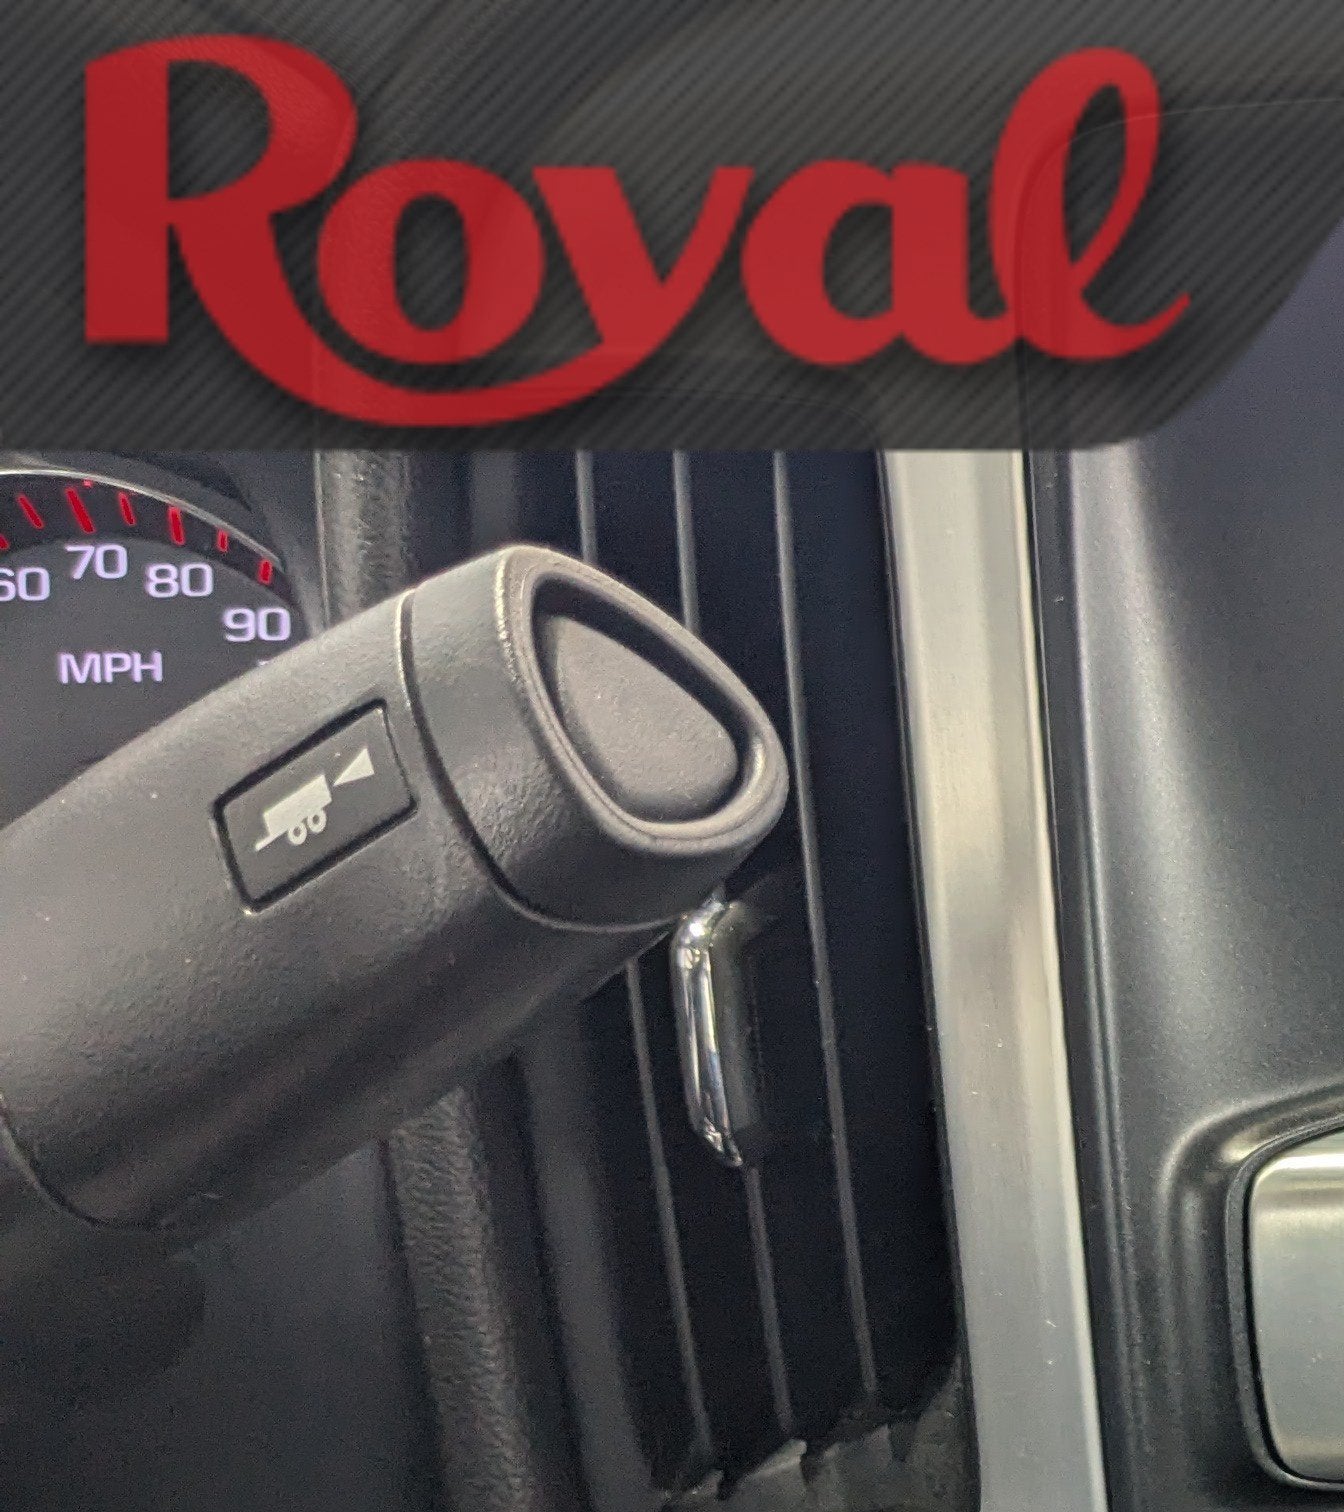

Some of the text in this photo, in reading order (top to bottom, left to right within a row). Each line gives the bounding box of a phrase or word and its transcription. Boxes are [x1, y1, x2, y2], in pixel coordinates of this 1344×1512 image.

[64, 543, 129, 581] 70
[145, 562, 214, 599] 80
[222, 606, 292, 643] 90
[58, 651, 164, 685] MPH
